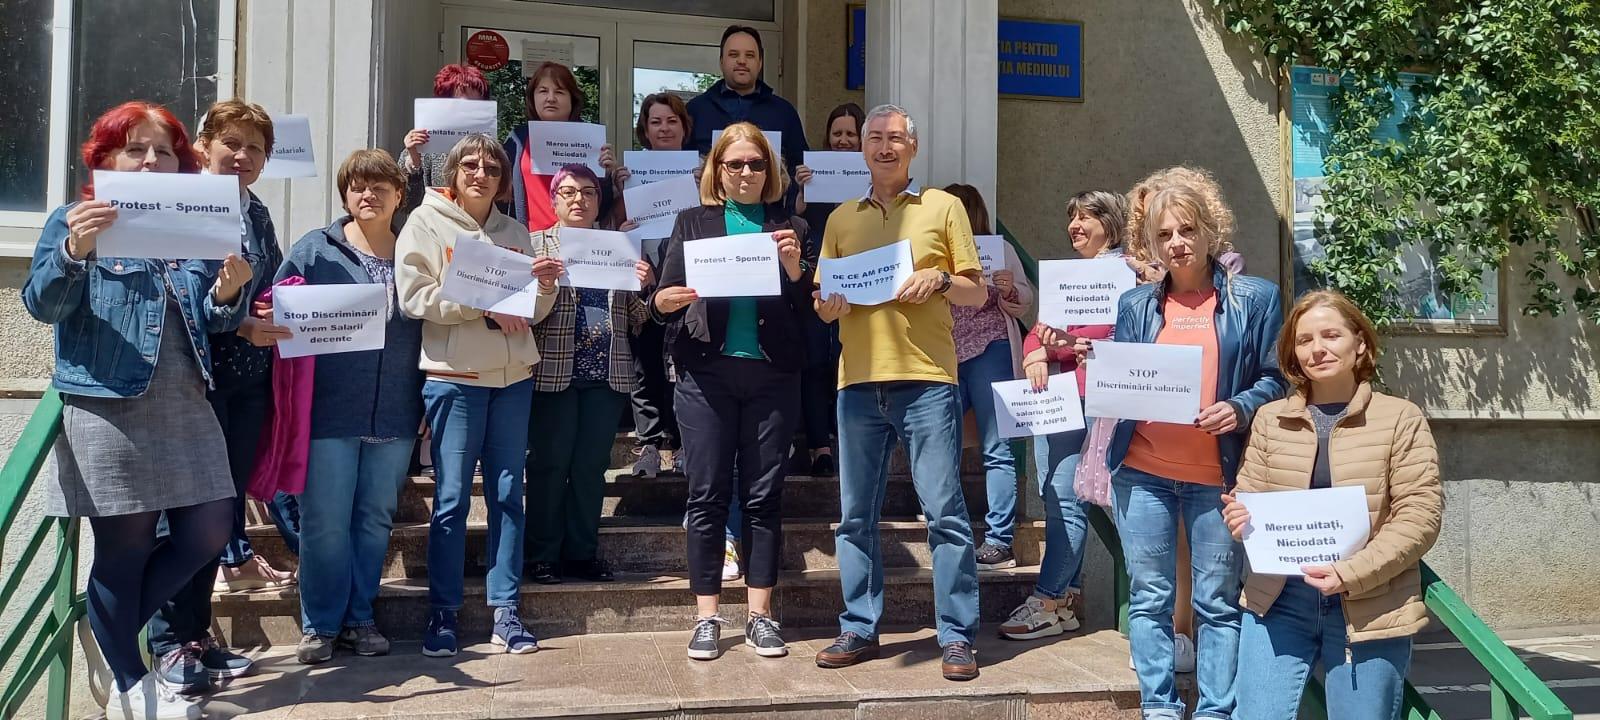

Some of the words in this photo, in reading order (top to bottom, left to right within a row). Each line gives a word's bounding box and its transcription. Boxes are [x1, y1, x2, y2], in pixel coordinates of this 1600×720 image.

[1015, 41, 1058, 56] PENTRU
[1017, 62, 1070, 78] MEDIULUI
[842, 169, 870, 177] Spontan
[110, 199, 162, 211] Protest
[176, 202, 230, 214] Spontan
[652, 199, 672, 208] STOP
[591, 249, 613, 257] STOP
[694, 256, 727, 264] Protest
[735, 255, 772, 263] Spontan
[485, 266, 507, 278] STOP
[862, 269, 876, 278] AM
[878, 262, 901, 274] FOST
[874, 275, 894, 285] ????
[283, 311, 309, 320] Stop
[311, 309, 379, 319] Discriminării
[330, 323, 363, 331] Salarii
[310, 335, 352, 343] decente
[1129, 368, 1158, 378] STOP
[1154, 384, 1192, 394] salariale
[1016, 409, 1044, 417] salariu
[1045, 406, 1063, 415] egal
[1043, 416, 1067, 425] ANPM
[1265, 522, 1303, 532] Mereu
[1276, 536, 1336, 547] Niciodată
